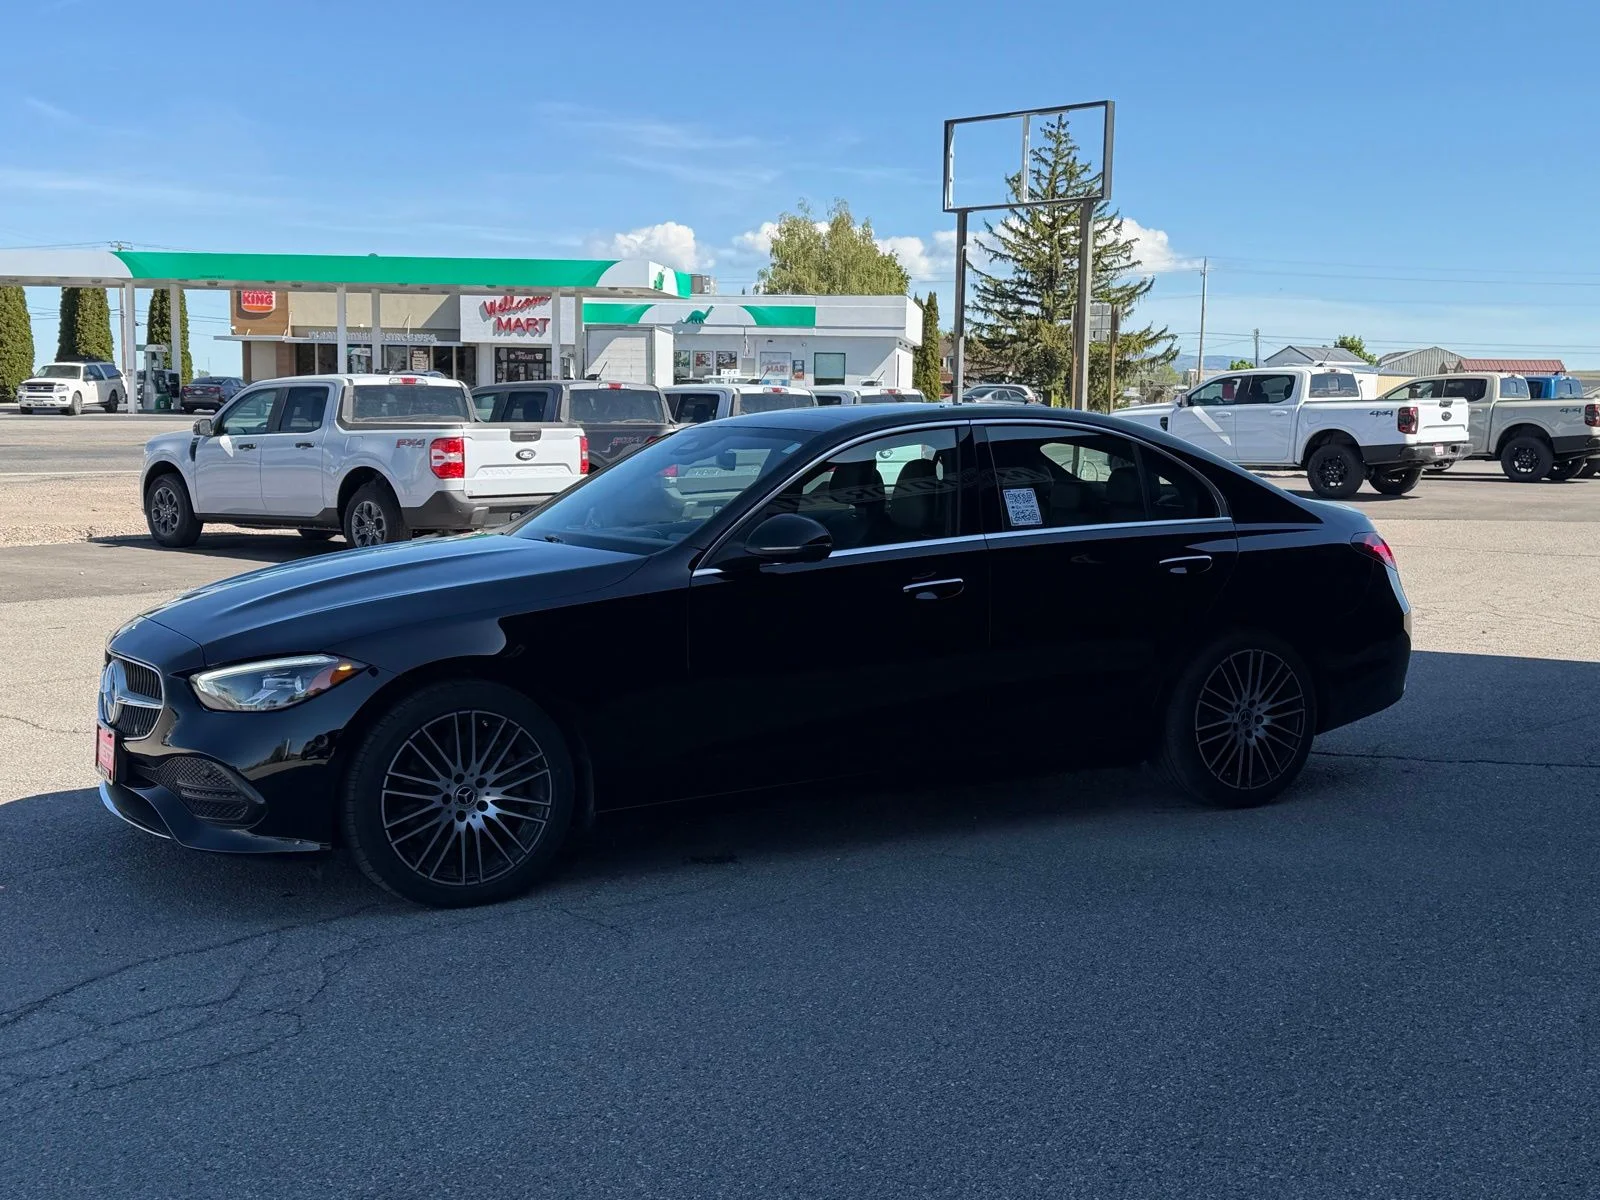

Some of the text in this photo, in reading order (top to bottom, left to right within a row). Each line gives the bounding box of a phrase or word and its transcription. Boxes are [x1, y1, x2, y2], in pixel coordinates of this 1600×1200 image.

[243, 293, 273, 306] KING
[496, 316, 551, 333] MART
[396, 438, 427, 449] FX4
